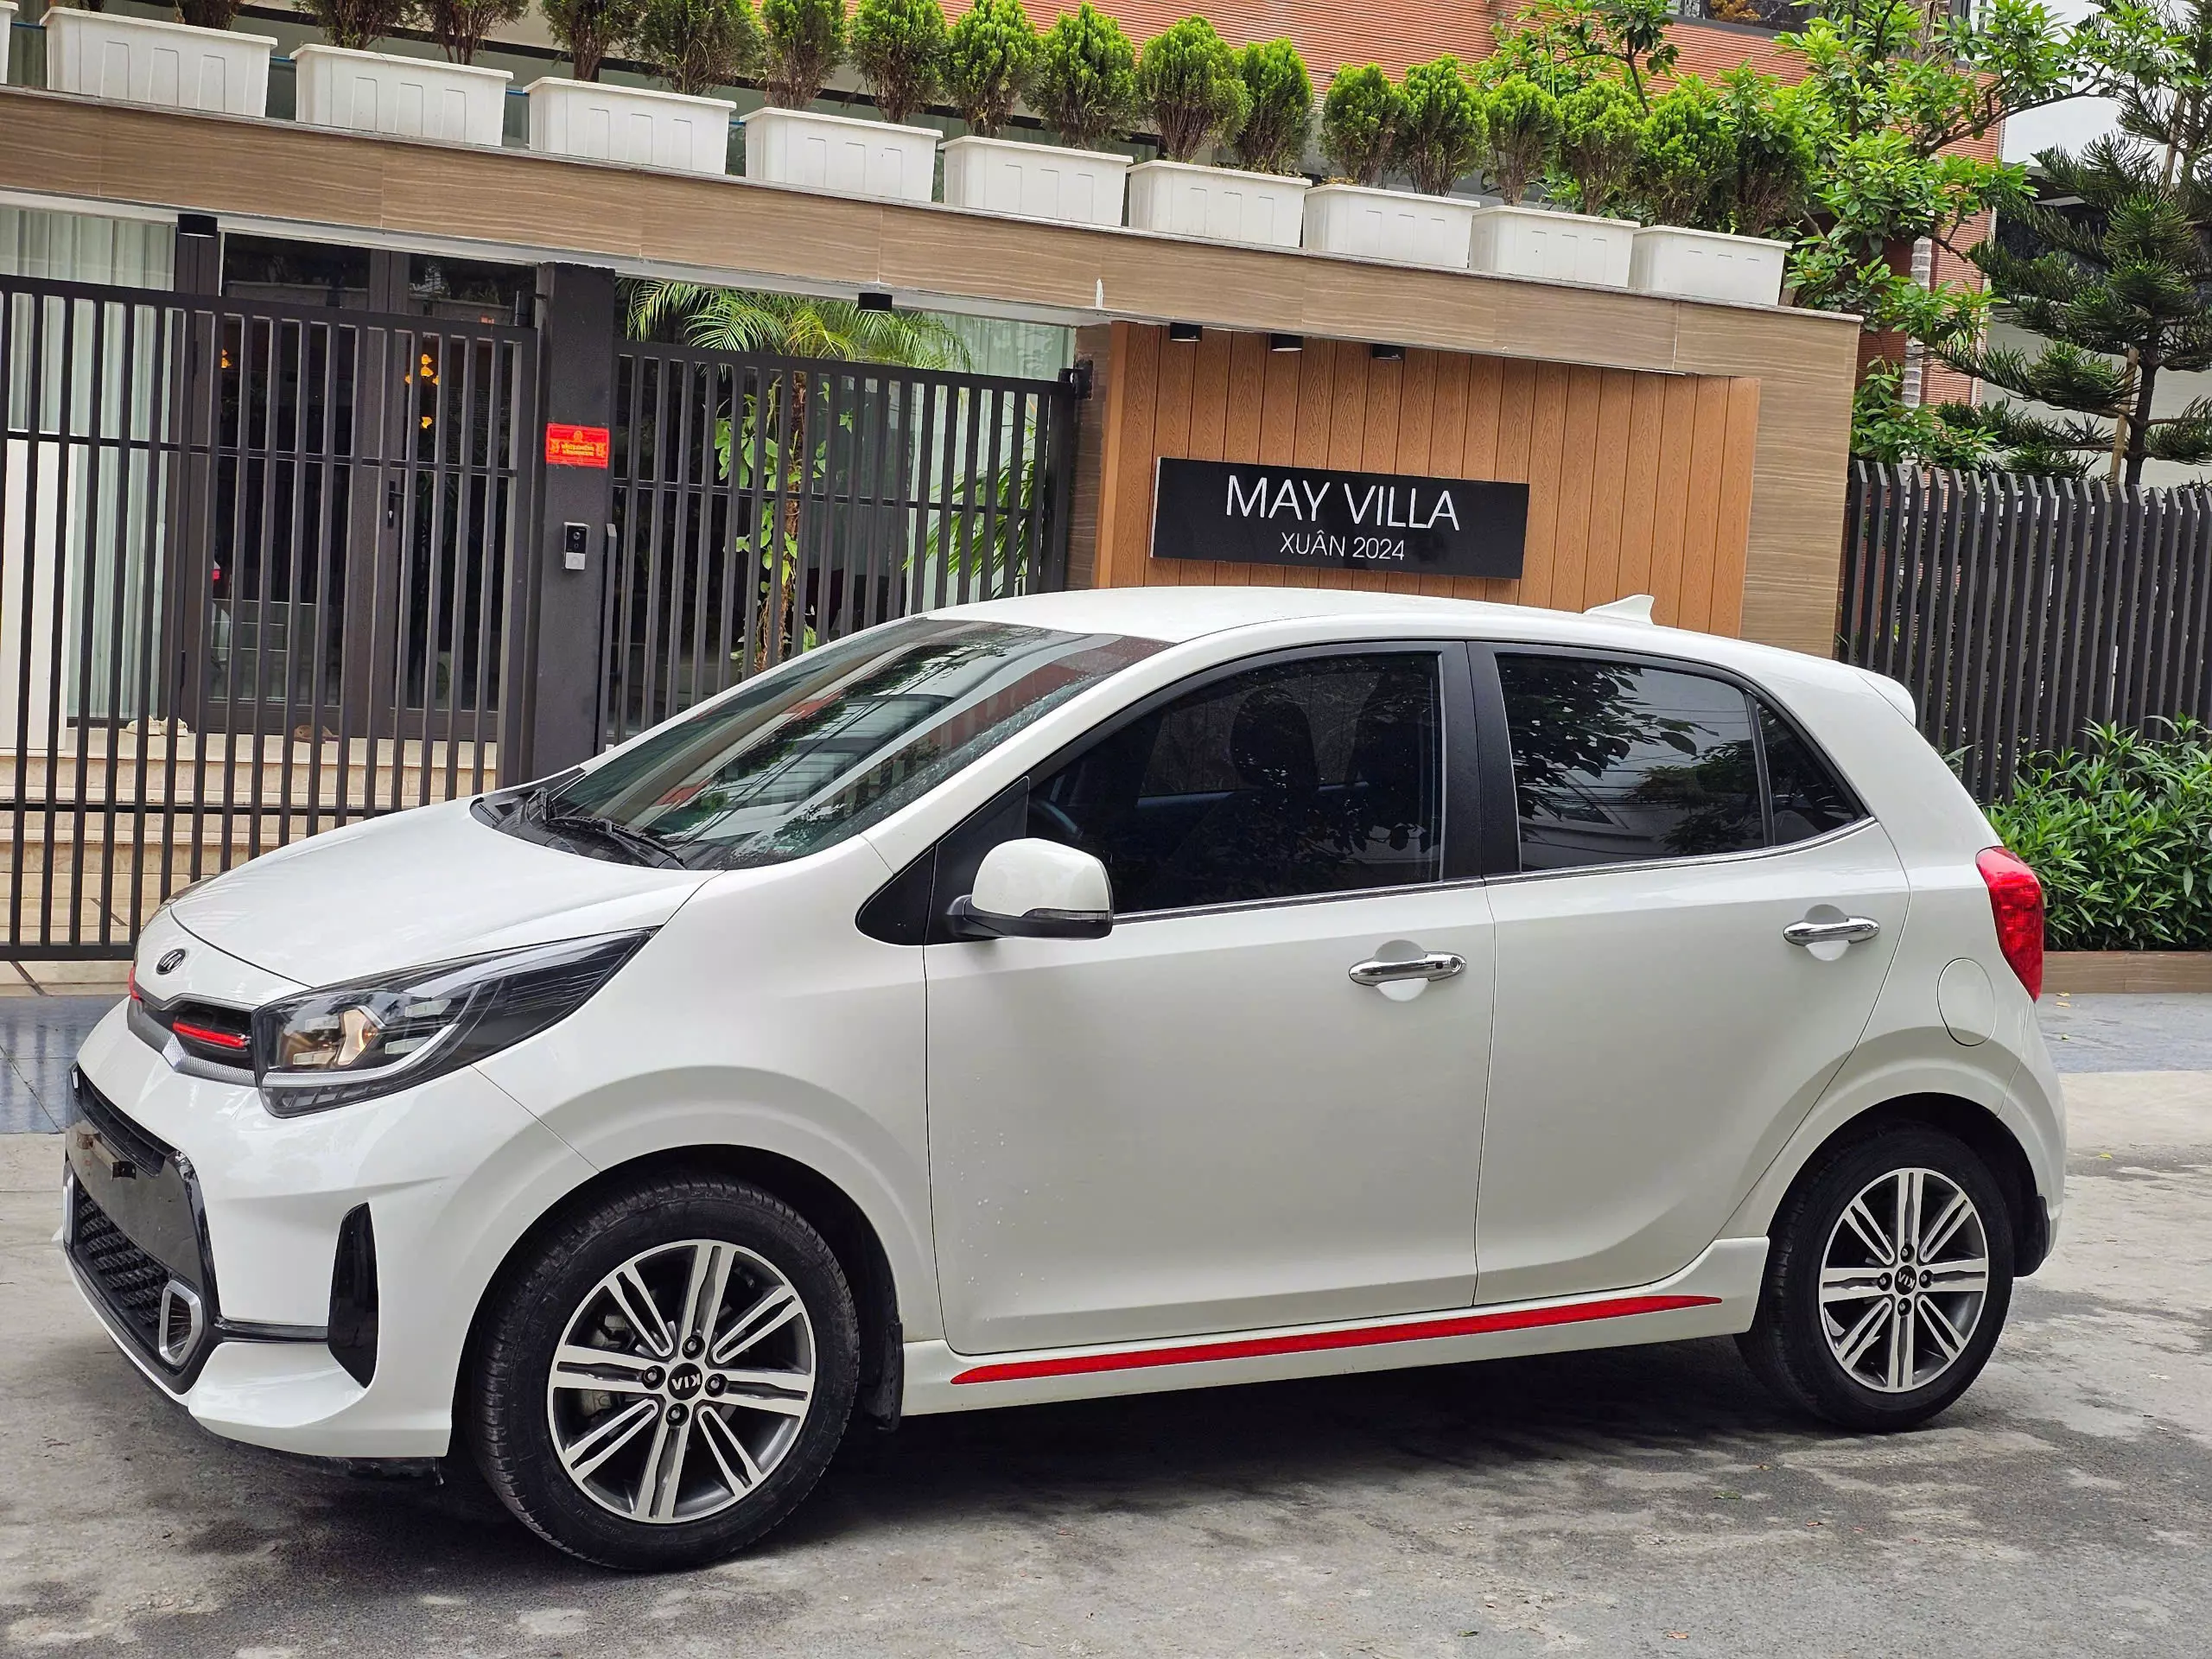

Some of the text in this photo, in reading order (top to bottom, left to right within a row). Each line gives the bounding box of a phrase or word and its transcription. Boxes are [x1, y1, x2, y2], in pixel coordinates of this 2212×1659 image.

[1226, 474, 1460, 531] MAY VILLA
[1280, 530, 1405, 561] XUÂN 2024
[1897, 1271, 1916, 1288] KIA
[671, 1373, 701, 1390] KIA
